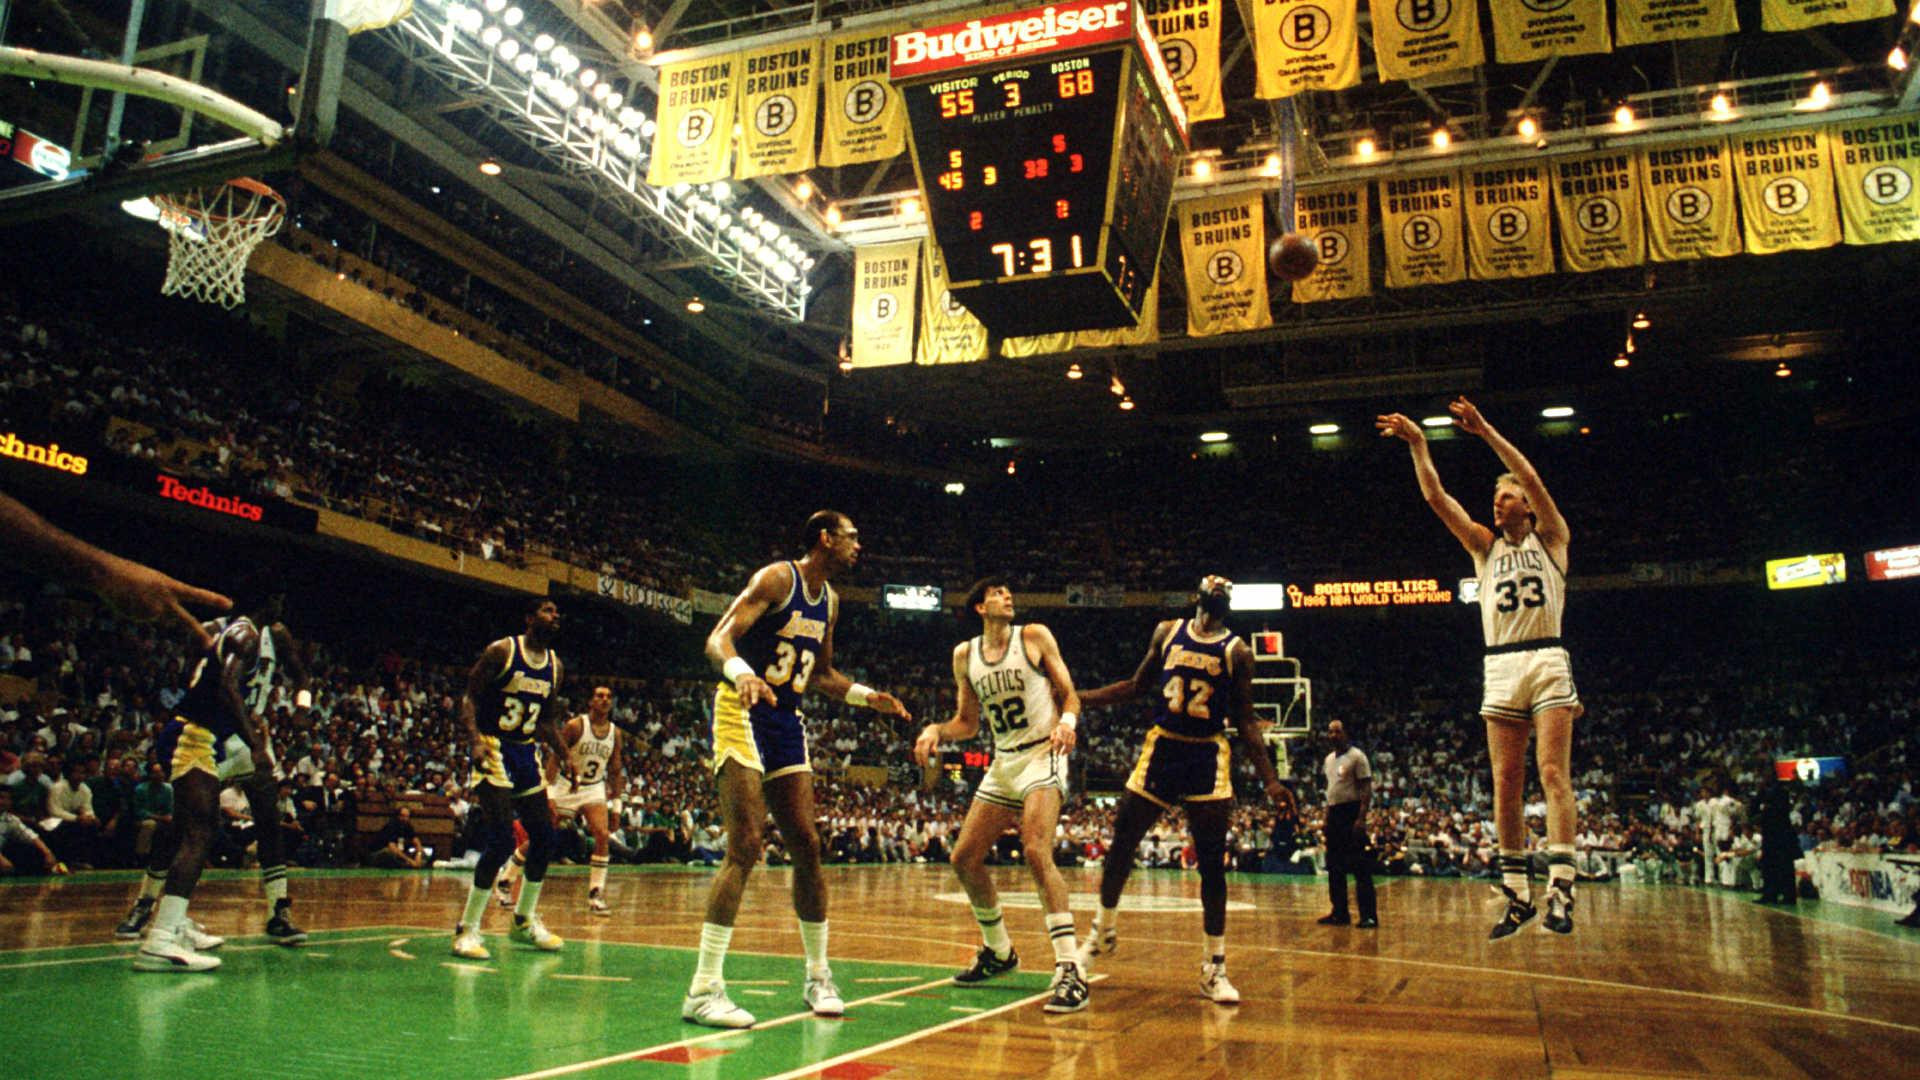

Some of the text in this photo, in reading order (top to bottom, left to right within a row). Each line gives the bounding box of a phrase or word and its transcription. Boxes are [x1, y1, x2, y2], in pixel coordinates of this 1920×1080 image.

[893, 1, 1127, 65] Budweiser
[1150, 11, 1208, 36] UINS
[1294, 13, 1314, 42] B
[834, 36, 888, 62] BOSTO
[748, 48, 811, 75] BOSTON
[834, 56, 887, 81] BRUIN
[1051, 58, 1090, 74] BOSTON
[670, 61, 731, 87] BOSTON
[746, 68, 809, 95] BRUINS
[929, 77, 978, 94] VISITOR
[992, 70, 1030, 84] PERIOD
[1058, 70, 1095, 98] 68
[669, 82, 729, 107] BRUINS
[855, 88, 873, 116] B
[940, 90, 975, 118] 55
[1003, 83, 1021, 108] 3
[687, 115, 704, 141] B
[767, 103, 784, 129] B
[1052, 134, 1066, 154] 5
[1743, 134, 1817, 157] BOSTON
[1842, 123, 1920, 145] BOSTON
[950, 150, 962, 169] 5
[1070, 153, 1083, 173] 3
[1560, 155, 1628, 178] BOSTON
[1650, 145, 1719, 167] BOSTON
[1746, 153, 1820, 176] BRUINS
[938, 166, 997, 190] 45 3
[1387, 176, 1450, 196] BOSTON
[1473, 167, 1538, 187] BOSTON
[1562, 174, 1630, 197] BRUINS
[1651, 163, 1721, 186] BRUINS
[1876, 172, 1898, 198] B
[1298, 191, 1358, 212] BOSTON
[1390, 194, 1452, 214] BRUINS
[1475, 185, 1539, 205] BRUINS
[1679, 193, 1699, 218] B
[1776, 183, 1797, 208] B
[1192, 205, 1250, 228] BOSTON
[1298, 209, 1358, 229] BRUINS
[1500, 213, 1518, 237] B
[1589, 204, 1608, 228] B
[1194, 224, 1251, 246] BRUINS
[1321, 236, 1338, 254] B
[1413, 221, 1430, 245] B
[864, 258, 909, 274] BOSTON
[991, 235, 1082, 277] 7:31
[1216, 257, 1234, 278] B
[864, 273, 908, 289] BRUINS
[878, 298, 890, 318] B
[0, 433, 88, 475] chnics
[157, 474, 263, 521] Technics
[1494, 550, 1542, 578] CELTICS
[1314, 580, 1438, 595] BOSTON CELTICS
[1330, 594, 1351, 606] NBA
[1354, 593, 1389, 606] WORLD
[1393, 591, 1452, 605] CHAMPIONS
[1495, 576, 1546, 613] 33
[765, 641, 815, 693] 33
[976, 668, 1025, 701] CELTICS
[1163, 675, 1214, 719] 42
[989, 696, 1029, 734] 32
[583, 760, 599, 778] 3
